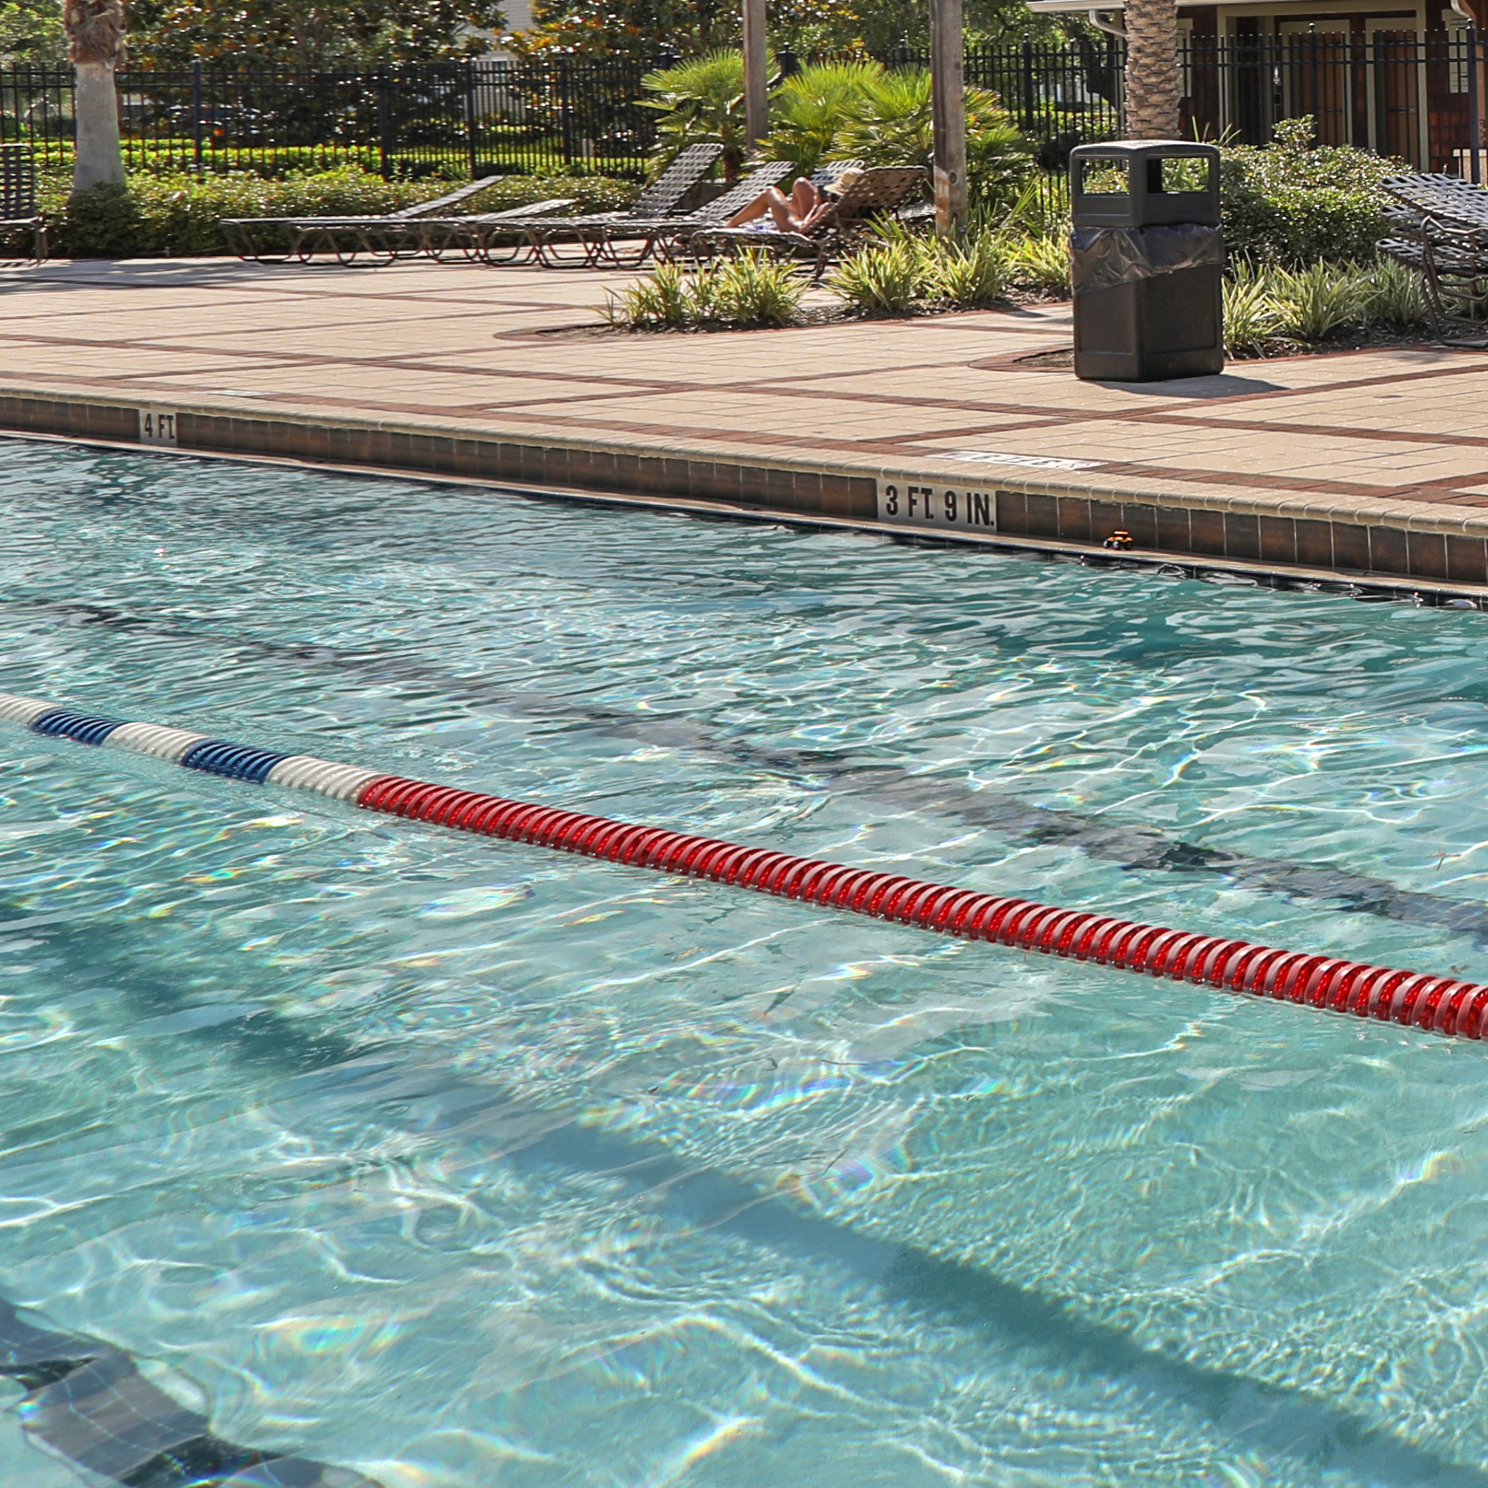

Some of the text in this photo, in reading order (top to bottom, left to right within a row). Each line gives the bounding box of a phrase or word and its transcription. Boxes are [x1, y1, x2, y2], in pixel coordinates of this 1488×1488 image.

[145, 413, 175, 440] 4 FT.
[885, 485, 995, 526] 3 FT. 9 IN.
